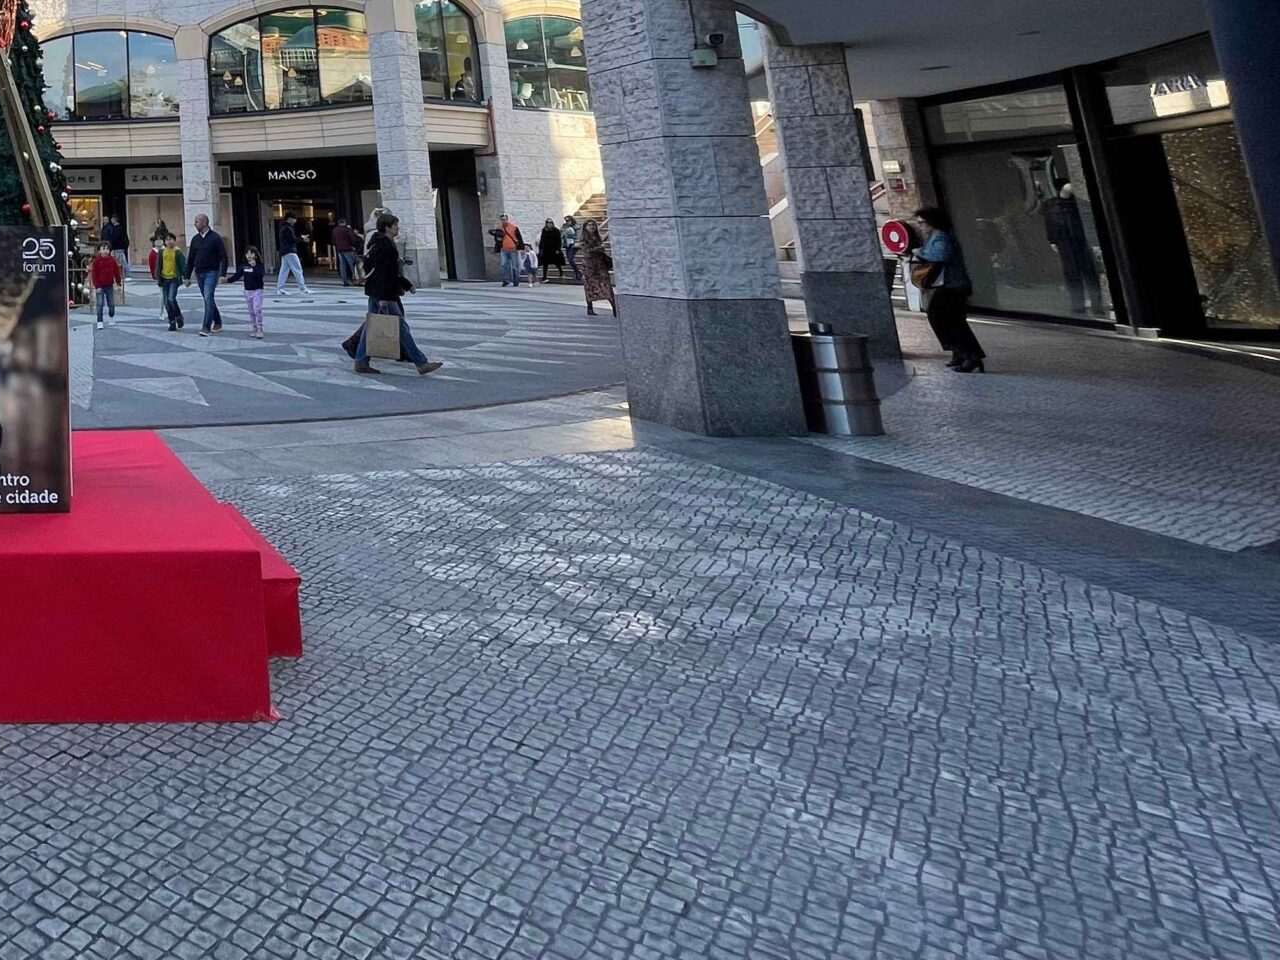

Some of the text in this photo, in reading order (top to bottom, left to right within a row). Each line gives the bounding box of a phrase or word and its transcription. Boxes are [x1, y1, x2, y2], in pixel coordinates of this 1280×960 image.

[66, 175, 95, 183] OME
[131, 174, 169, 183] ZARA
[268, 169, 317, 181] MANGO
[22, 237, 56, 260] 25
[22, 261, 56, 273] forum
[6, 490, 58, 504] cidade
